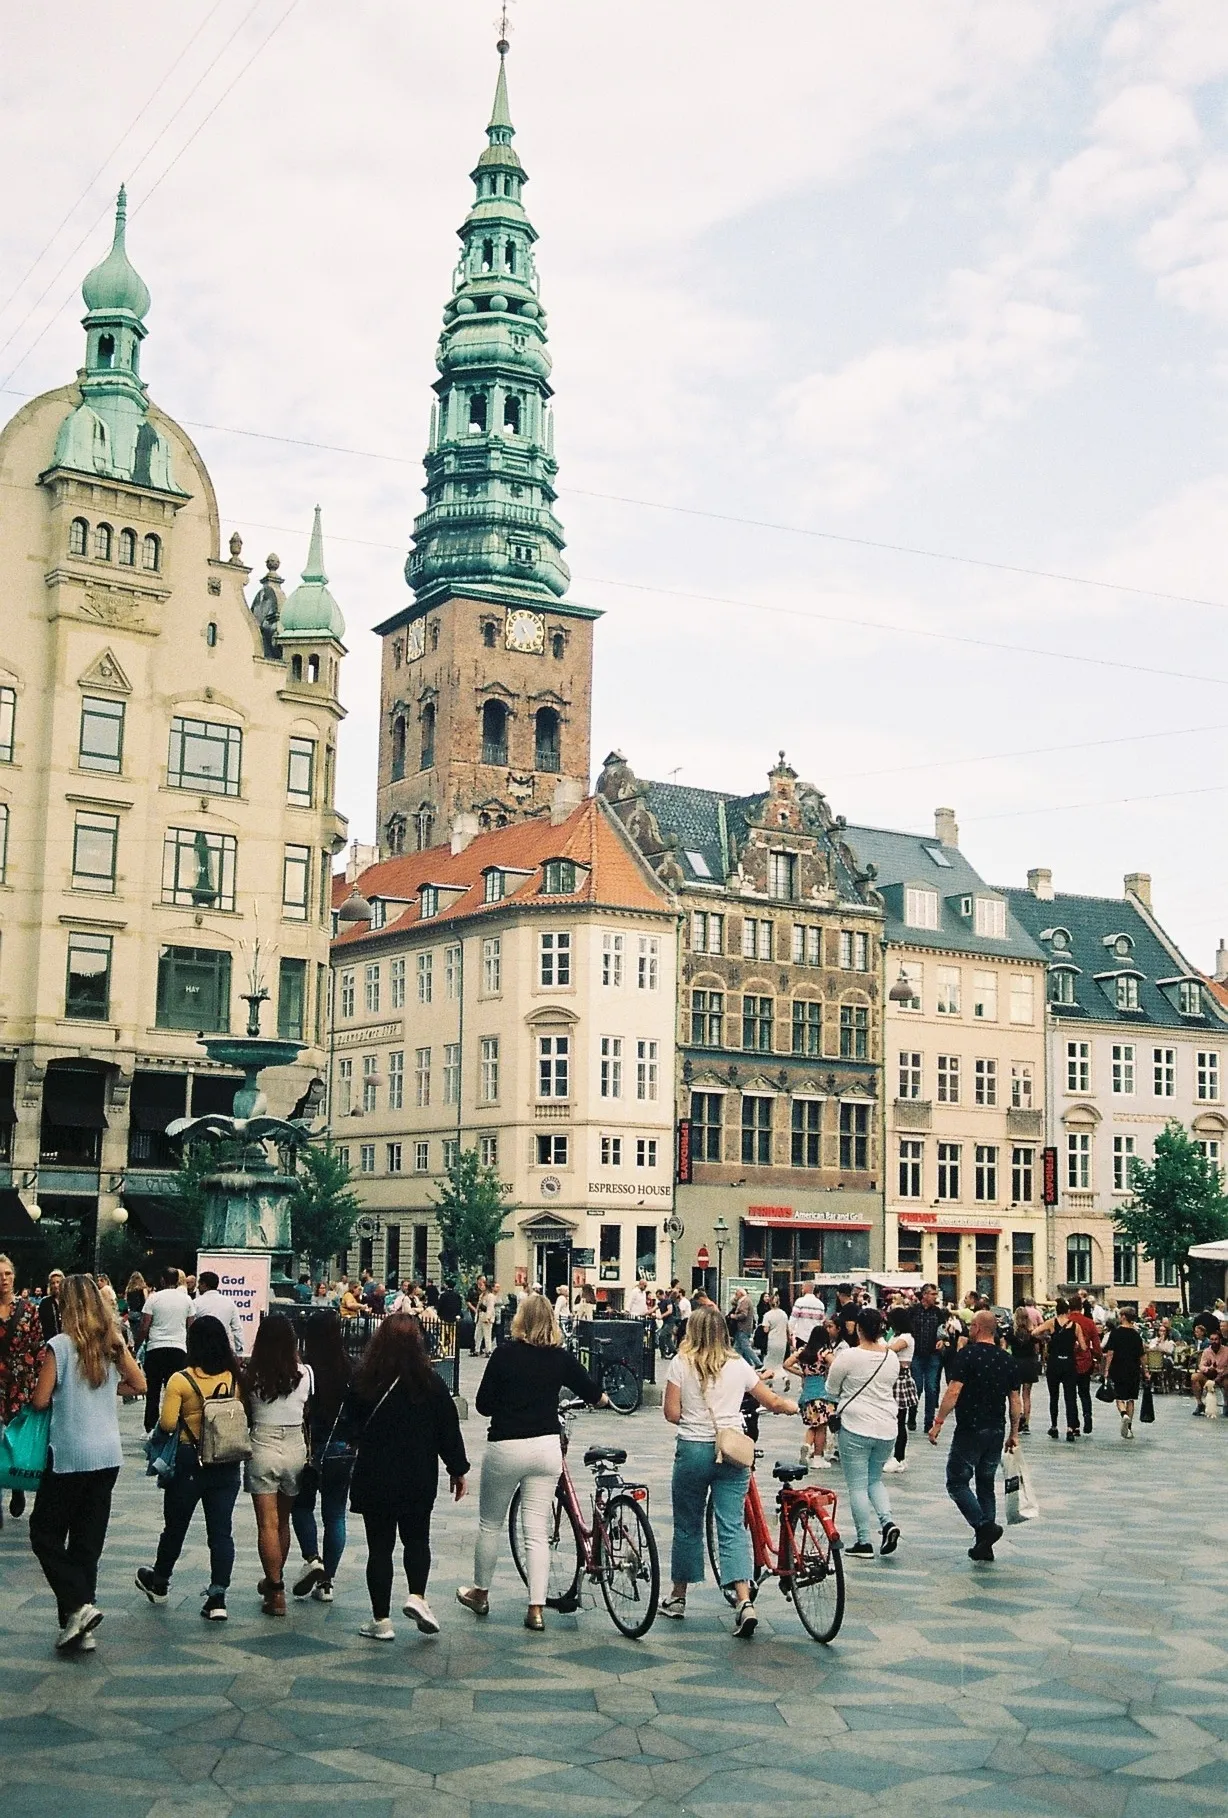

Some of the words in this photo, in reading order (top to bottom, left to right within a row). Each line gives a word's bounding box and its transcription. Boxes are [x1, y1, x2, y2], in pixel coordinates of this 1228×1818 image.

[185, 985, 200, 993] HAY
[681, 1129, 689, 1180] FRIDAYS
[1045, 1156, 1055, 1202] FRIDAYS
[588, 1182, 636, 1195] ESPRESSO
[637, 1185, 671, 1196] HOUSE
[795, 1210, 825, 1219] American
[825, 1211, 836, 1220] Bar
[221, 1275, 245, 1285] God
[234, 1300, 251, 1308] od
